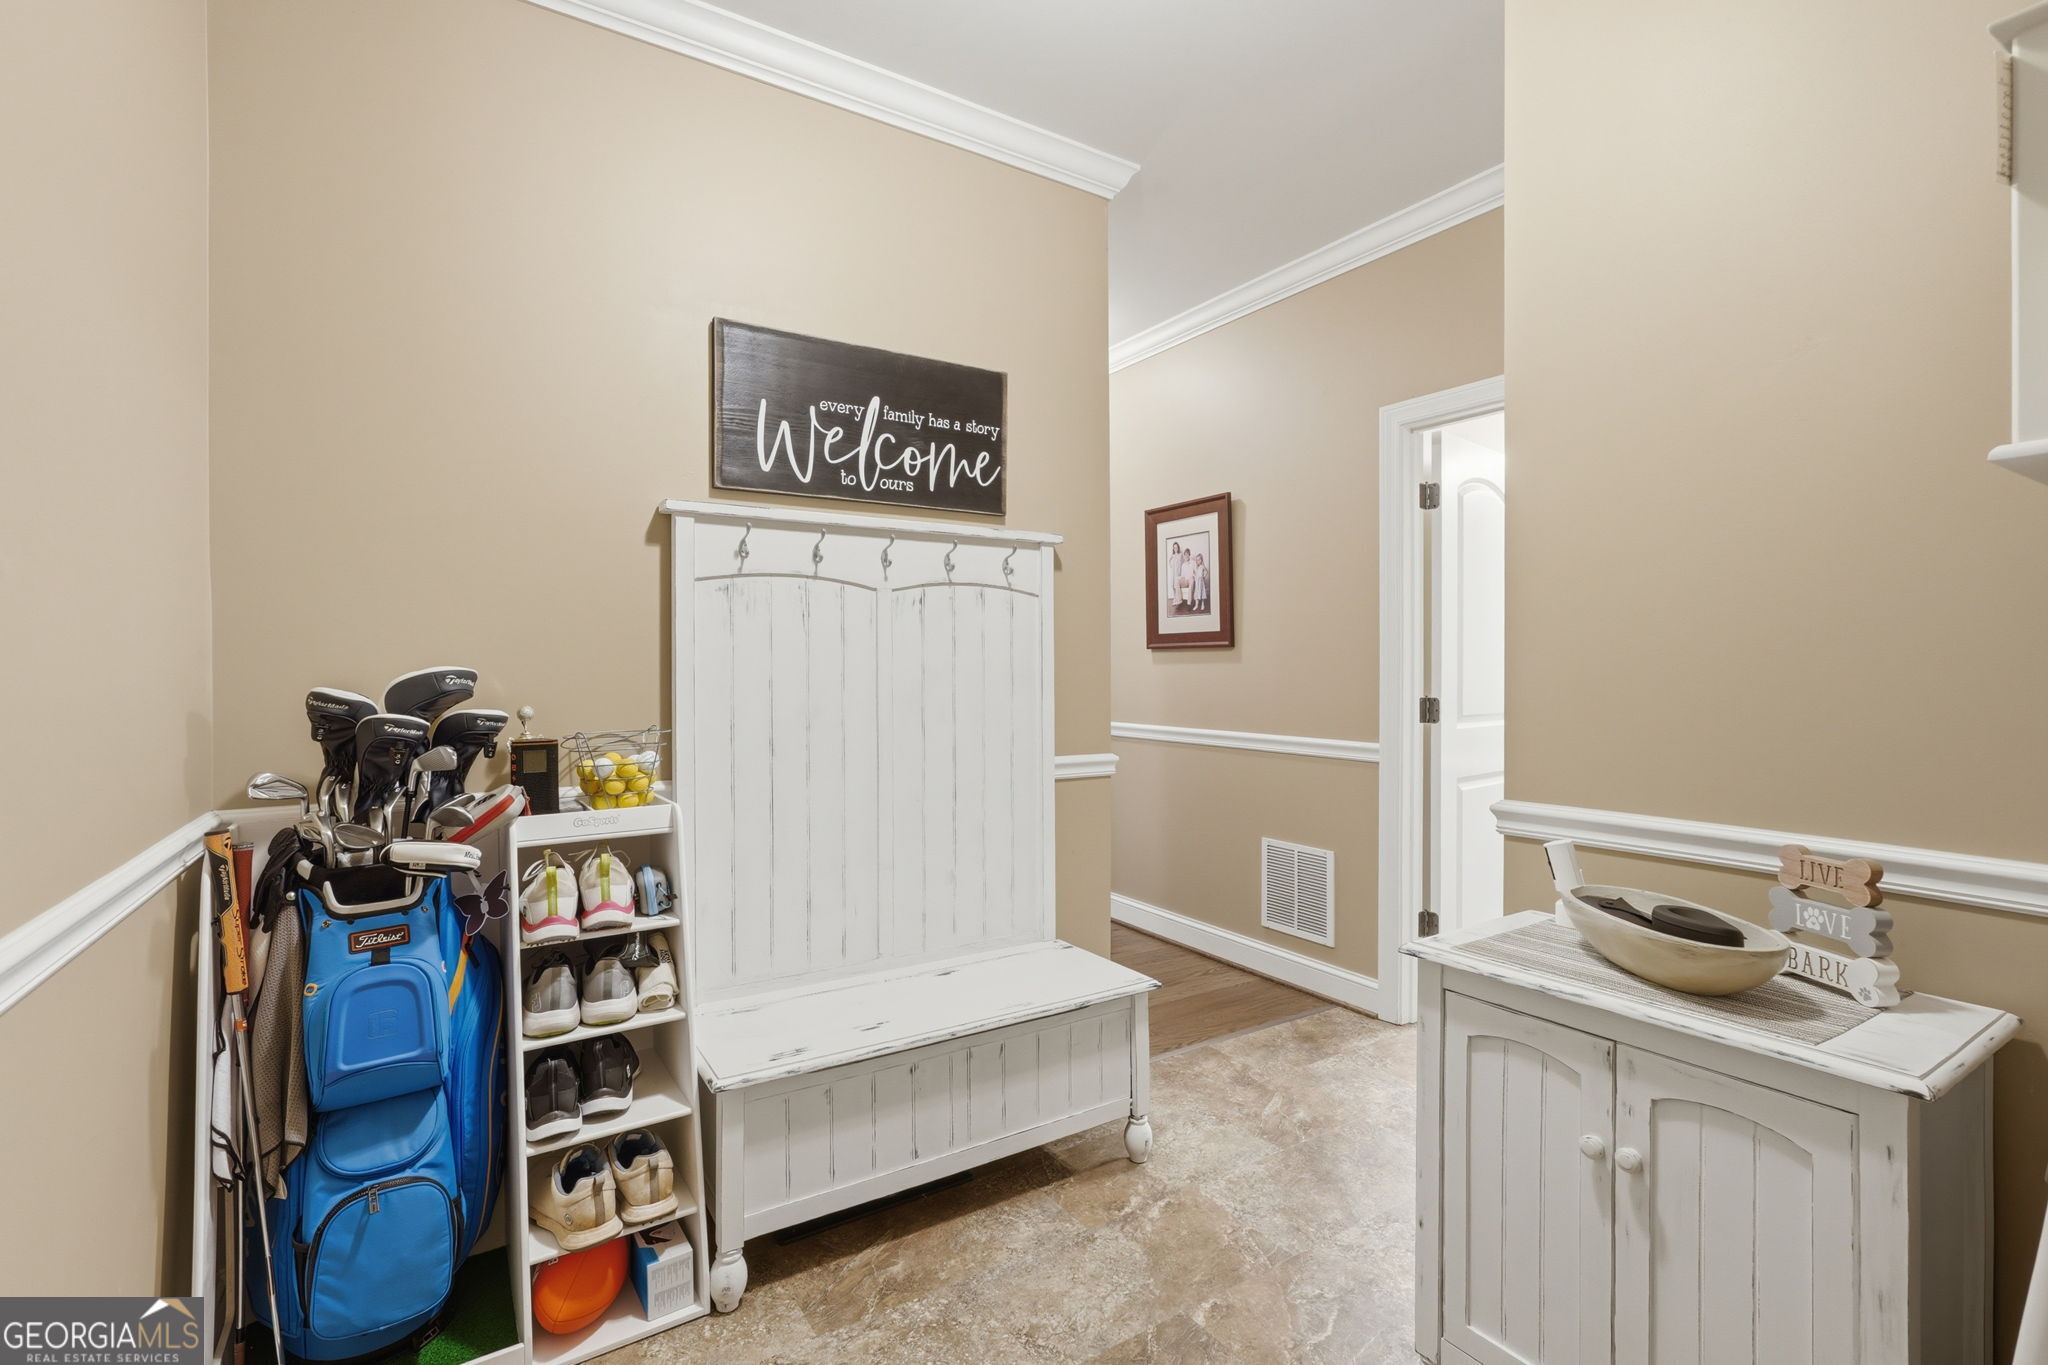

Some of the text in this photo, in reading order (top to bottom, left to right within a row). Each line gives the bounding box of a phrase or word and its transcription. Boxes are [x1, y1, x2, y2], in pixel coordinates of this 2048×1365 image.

[819, 399, 1000, 440] every family has a story
[756, 396, 1001, 492] Welcome
[840, 469, 914, 492] to ours
[1799, 859, 1844, 889] LIVE
[355, 931, 405, 948] Titleist
[1788, 946, 1849, 988] BARK
